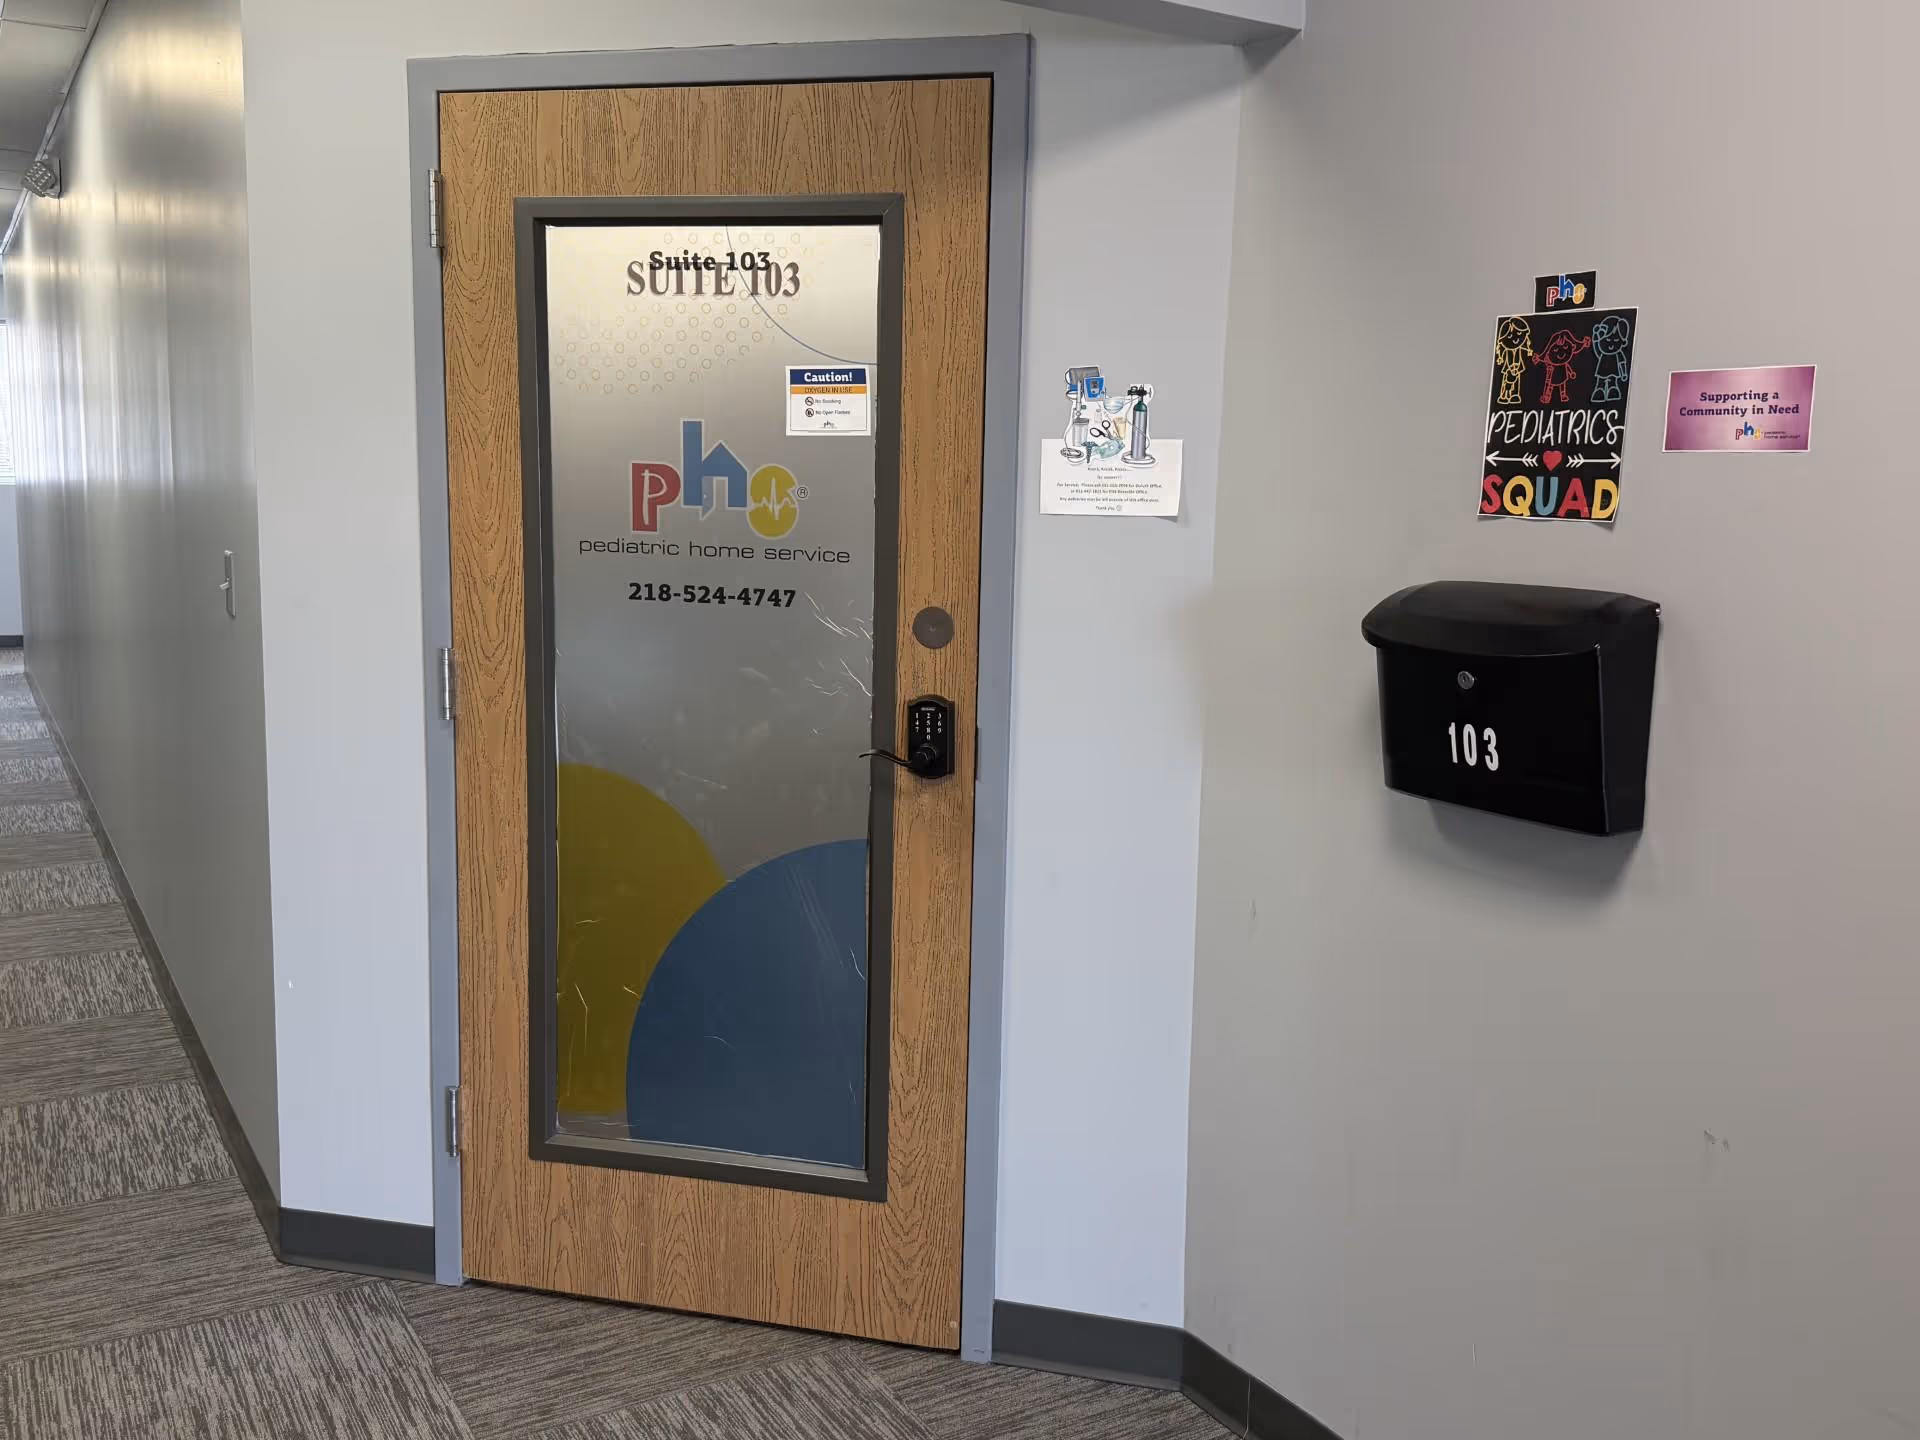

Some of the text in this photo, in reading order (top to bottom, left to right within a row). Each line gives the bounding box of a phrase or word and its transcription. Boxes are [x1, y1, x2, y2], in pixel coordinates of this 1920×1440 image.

[649, 249, 771, 271] Suite 103
[627, 260, 801, 297] SUITE 103
[803, 371, 853, 382] Caution!
[804, 386, 853, 394] OXYGEN IN USE
[1699, 390, 1780, 403] Supporting a
[1679, 404, 1800, 417] Community in Need
[1486, 409, 1624, 446] PEDIATRICS
[1481, 474, 1618, 519] SQUAD
[579, 538, 851, 564] pediatric home service
[628, 582, 797, 608] 218-524-4747
[1448, 721, 1499, 771] 103
